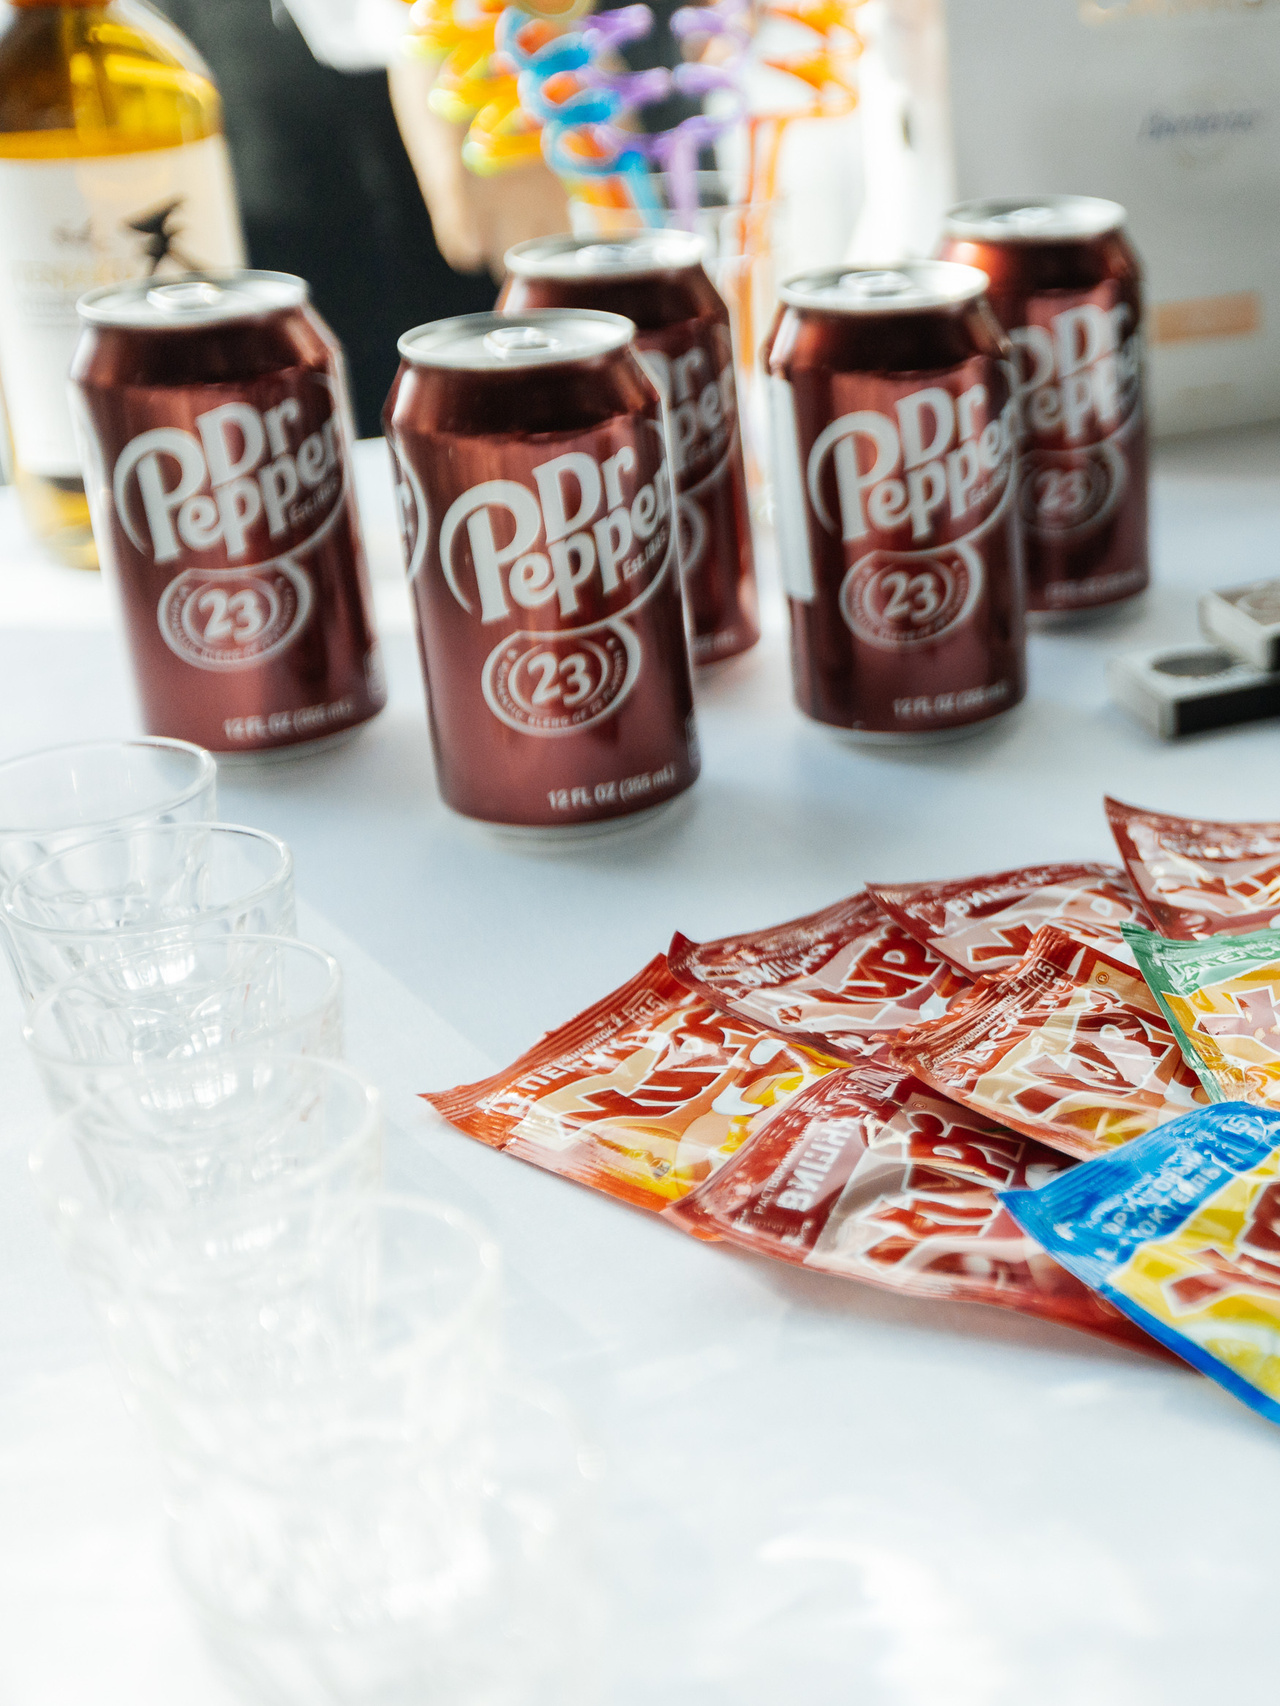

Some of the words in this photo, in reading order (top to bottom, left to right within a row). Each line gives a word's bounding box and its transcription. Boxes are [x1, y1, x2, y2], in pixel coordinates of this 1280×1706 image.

[196, 398, 301, 490] Dr
[807, 396, 1018, 544] Pepper
[894, 383, 987, 469] Dr
[113, 415, 340, 565] Pepper
[531, 445, 637, 545] Dr
[439, 460, 670, 625] Pepper
[199, 588, 263, 642] 23
[880, 570, 938, 622] 23
[526, 650, 593, 707] 23
[547, 788, 568, 812] 12
[570, 786, 592, 807] FL
[593, 780, 618, 805] OZ
